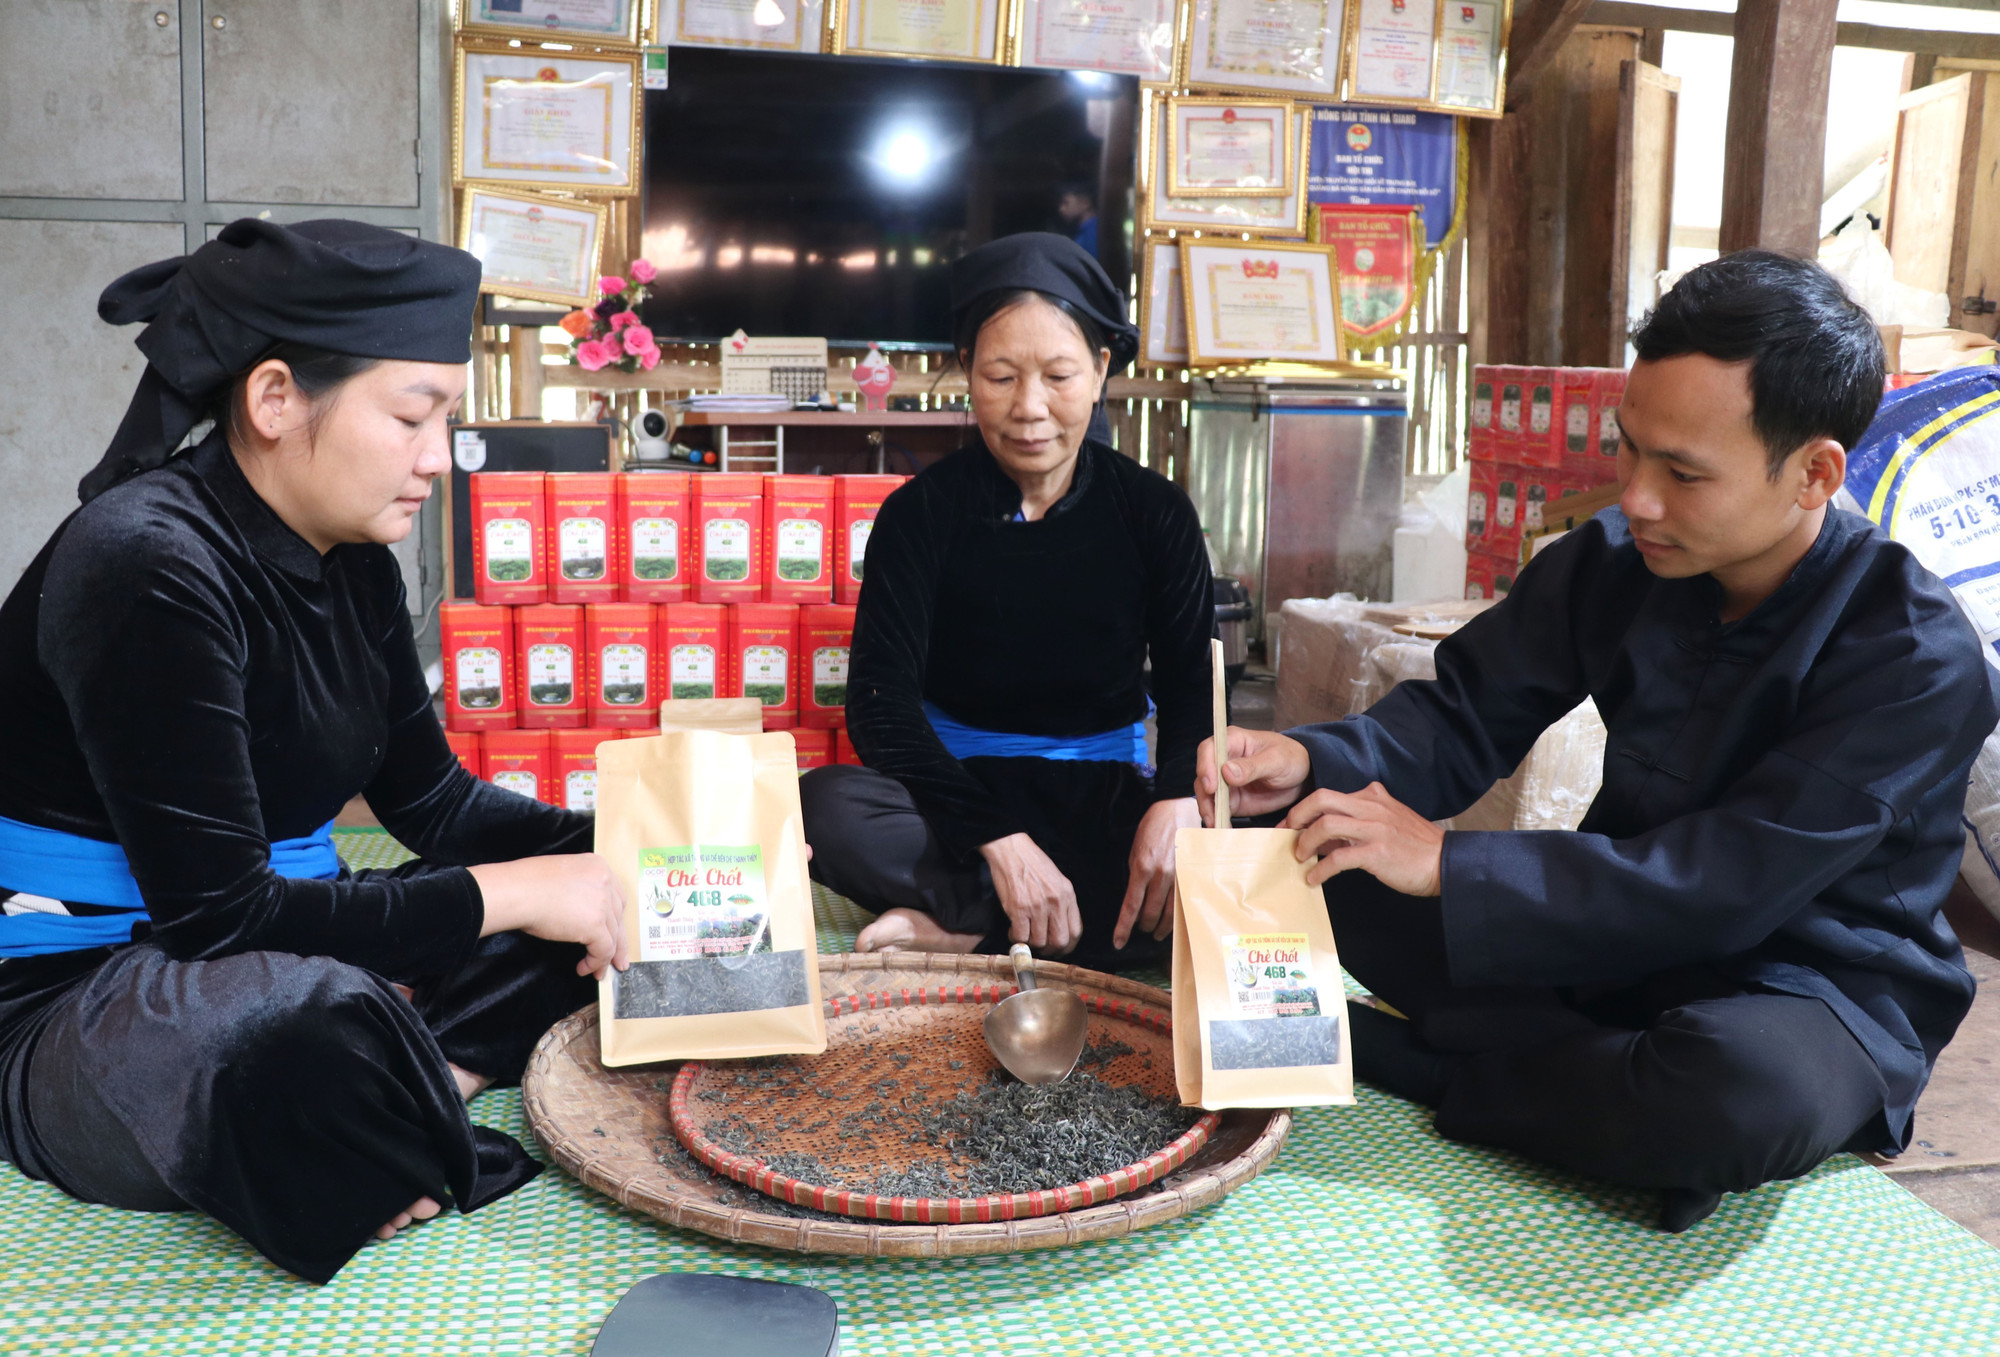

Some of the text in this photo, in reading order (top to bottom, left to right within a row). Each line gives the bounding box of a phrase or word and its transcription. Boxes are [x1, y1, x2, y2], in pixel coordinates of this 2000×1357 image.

[1318, 108, 1340, 121] NÔNG
[1393, 114, 1417, 125] GIANG
[667, 866, 744, 887] Chè Chốt
[1248, 947, 1299, 963] Chè Chốt
[1264, 966, 1286, 978] 468
